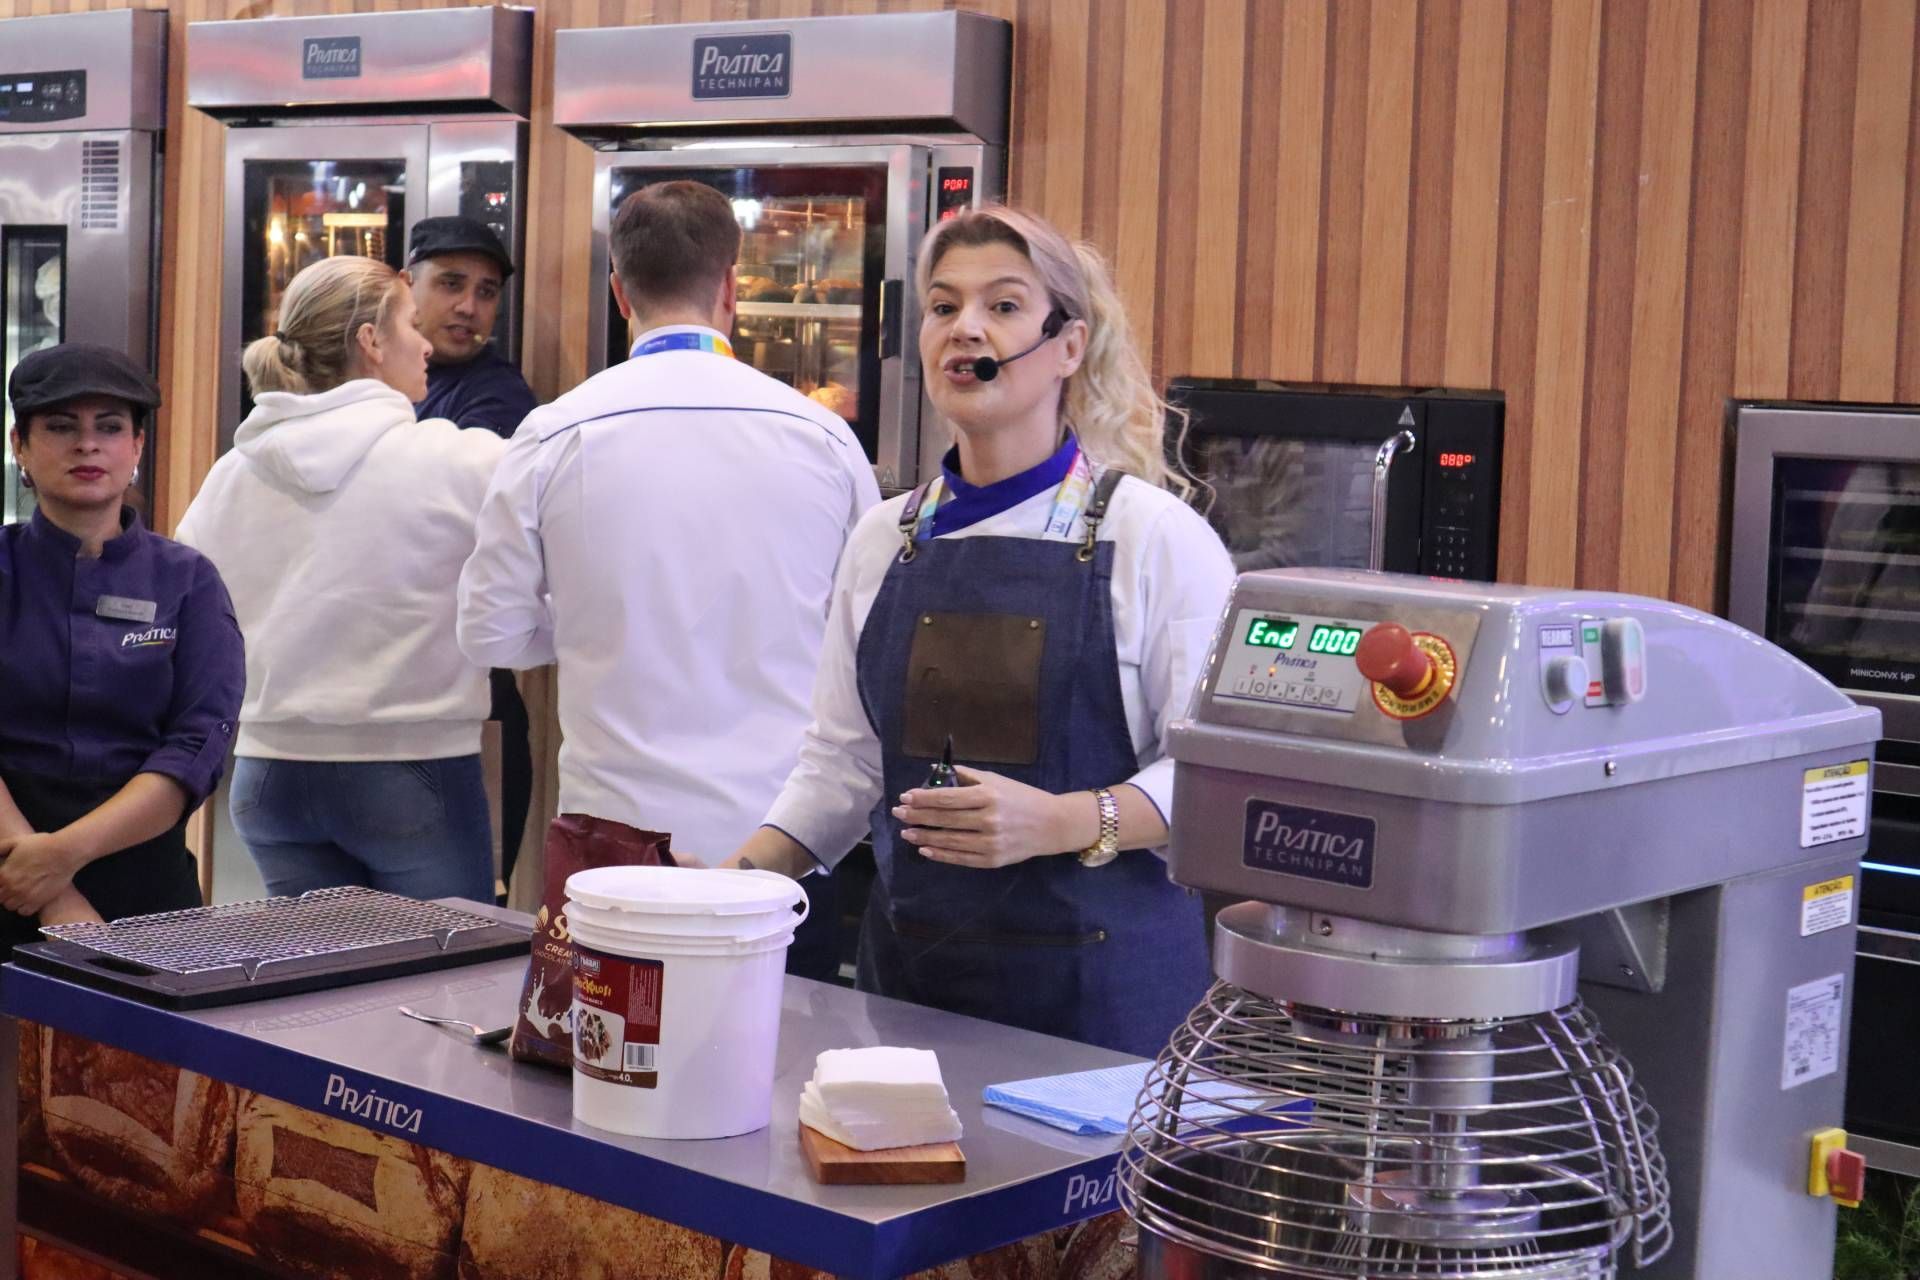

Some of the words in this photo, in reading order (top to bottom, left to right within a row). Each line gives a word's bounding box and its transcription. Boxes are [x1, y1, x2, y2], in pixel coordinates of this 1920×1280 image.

[700, 43, 784, 76] PRÁTICA
[700, 77, 783, 89] TECHNIPAN
[121, 626, 176, 646] PRÁTICA
[1249, 621, 1298, 649] End
[1309, 628, 1361, 655] 000
[1254, 811, 1364, 860] PRÁTICA
[1254, 846, 1363, 877] TECHNIPAN
[549, 915, 573, 943] S
[323, 1073, 423, 1134] PRÁTICA
